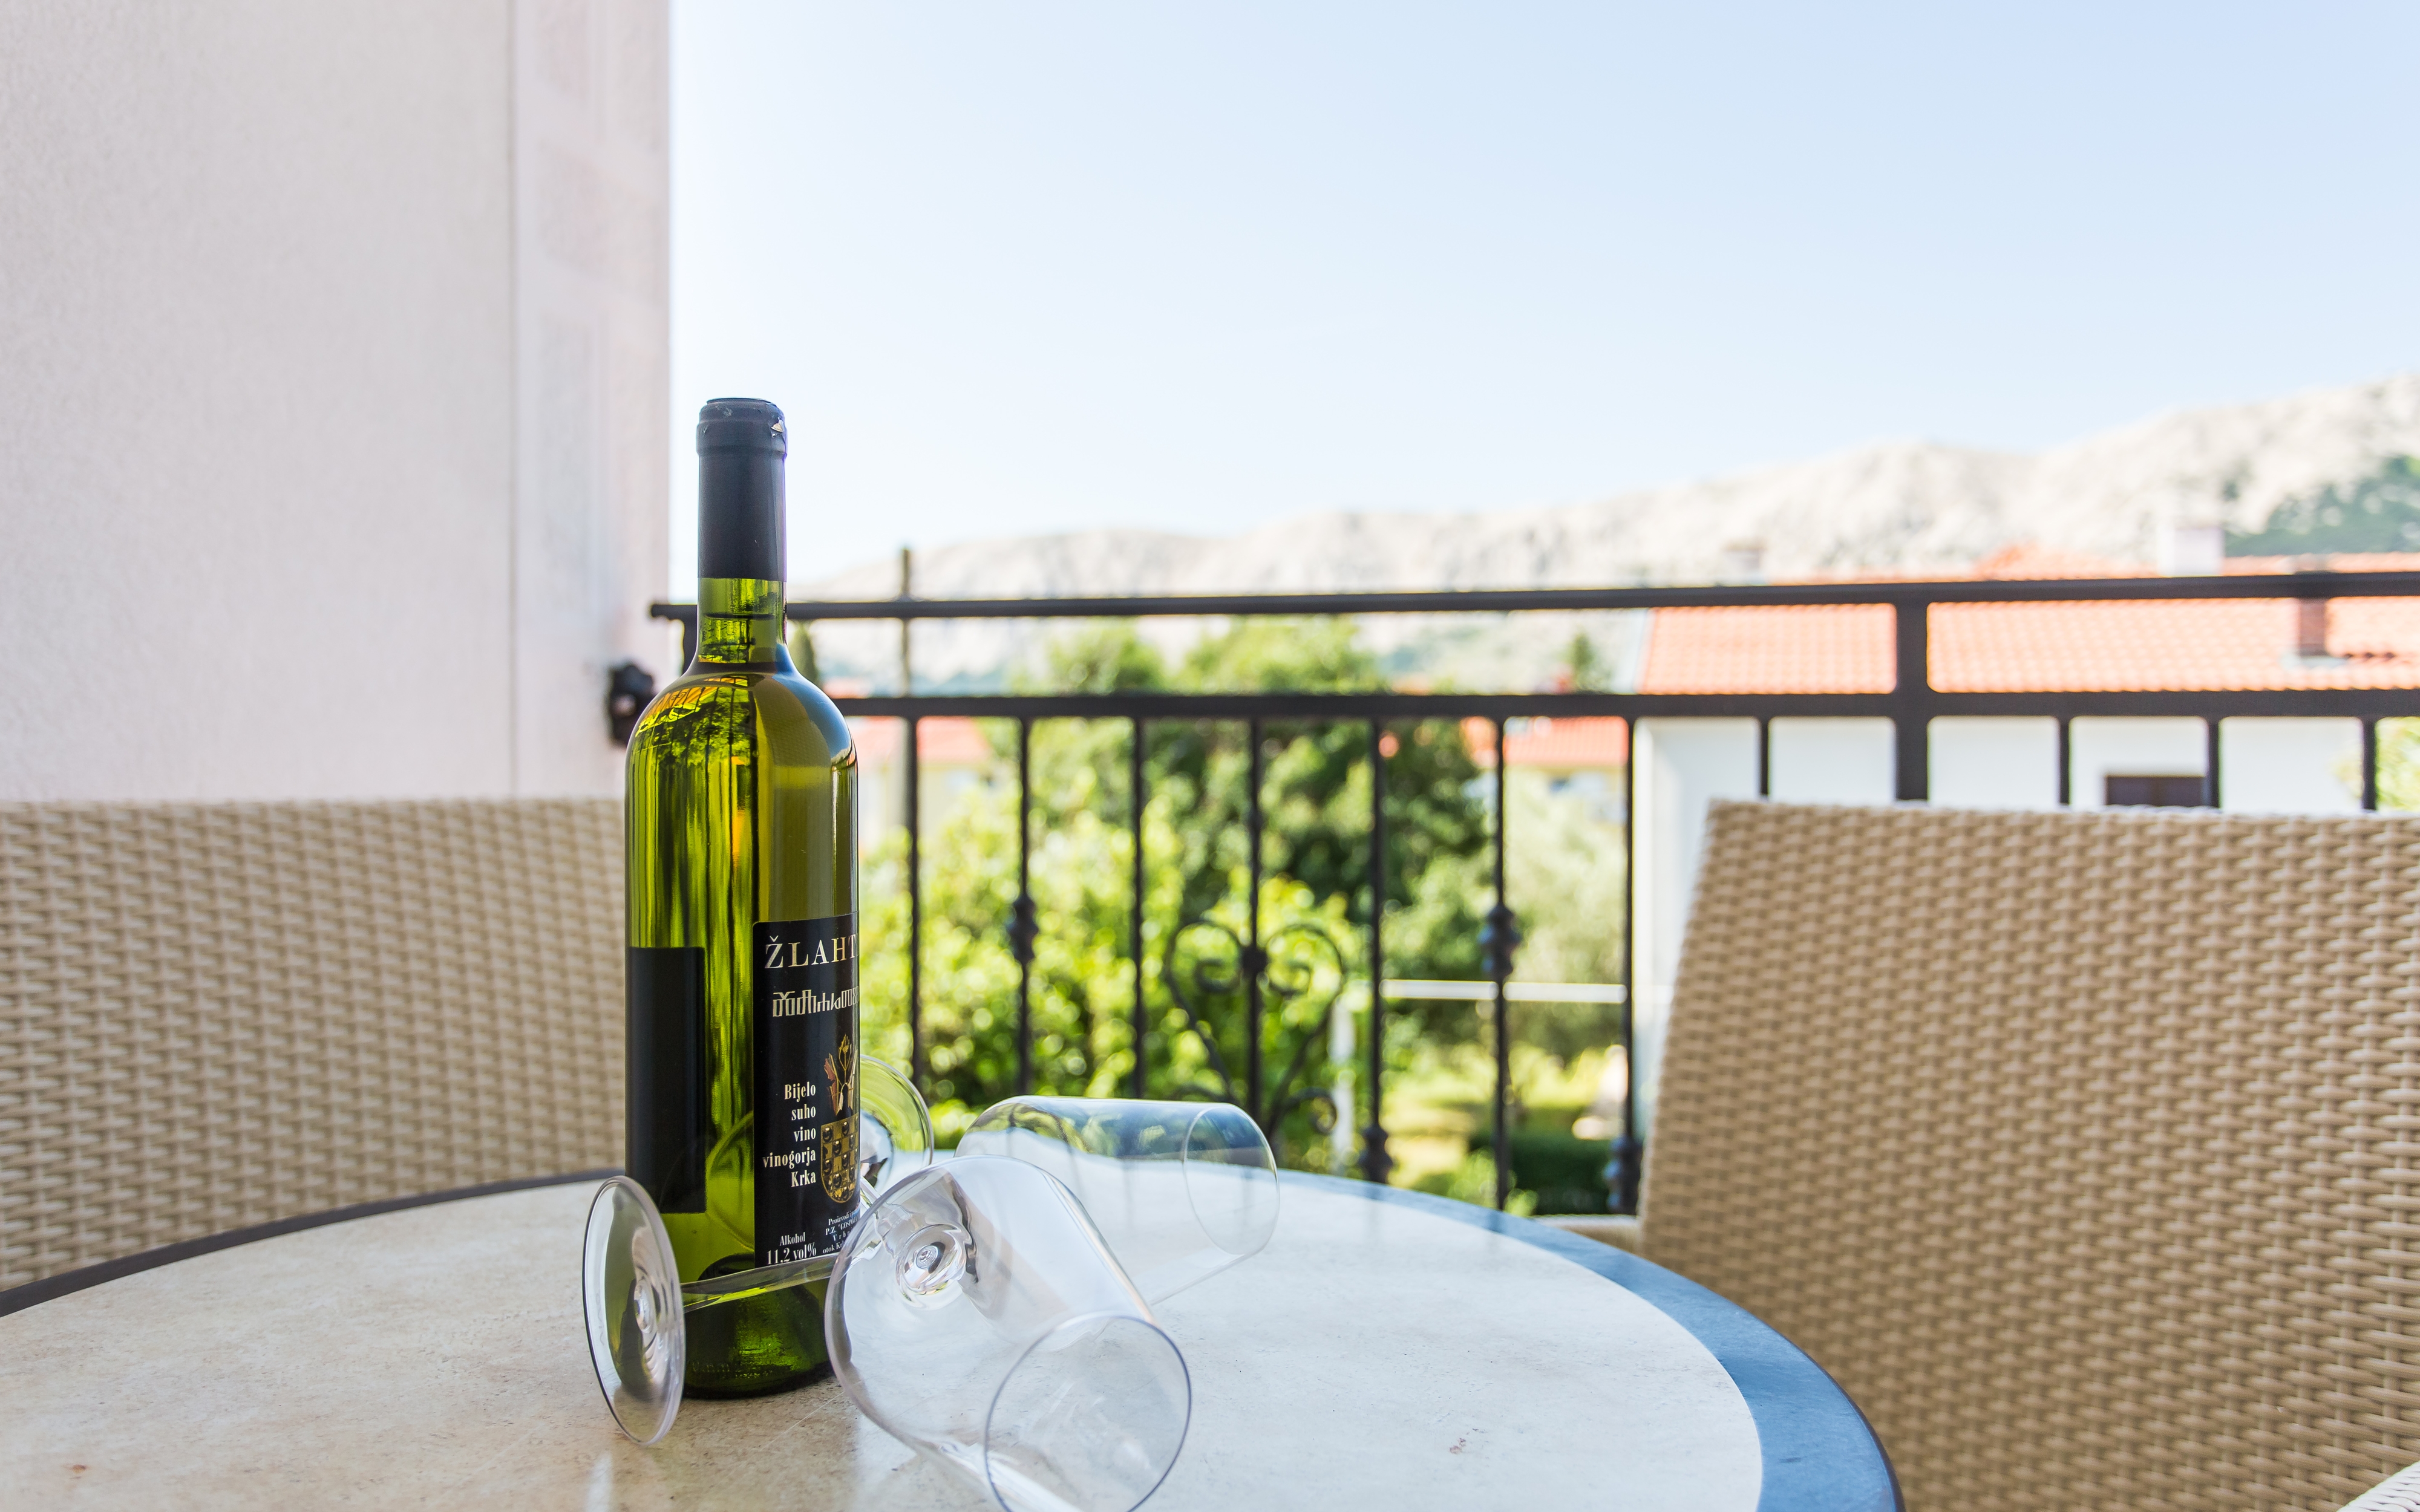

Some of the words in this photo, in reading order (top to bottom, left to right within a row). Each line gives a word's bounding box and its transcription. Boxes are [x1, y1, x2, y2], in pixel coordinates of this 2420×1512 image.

[765, 934, 858, 968] ŽLAHT
[784, 1081, 816, 1101] Bijelo
[791, 1104, 816, 1121] suho
[793, 1126, 816, 1142] vino
[762, 1147, 816, 1169] vinogorja
[791, 1170, 816, 1187] Krka
[779, 1231, 806, 1246] Alkohol
[793, 1242, 817, 1260] vol%
[822, 1245, 835, 1254] otok
